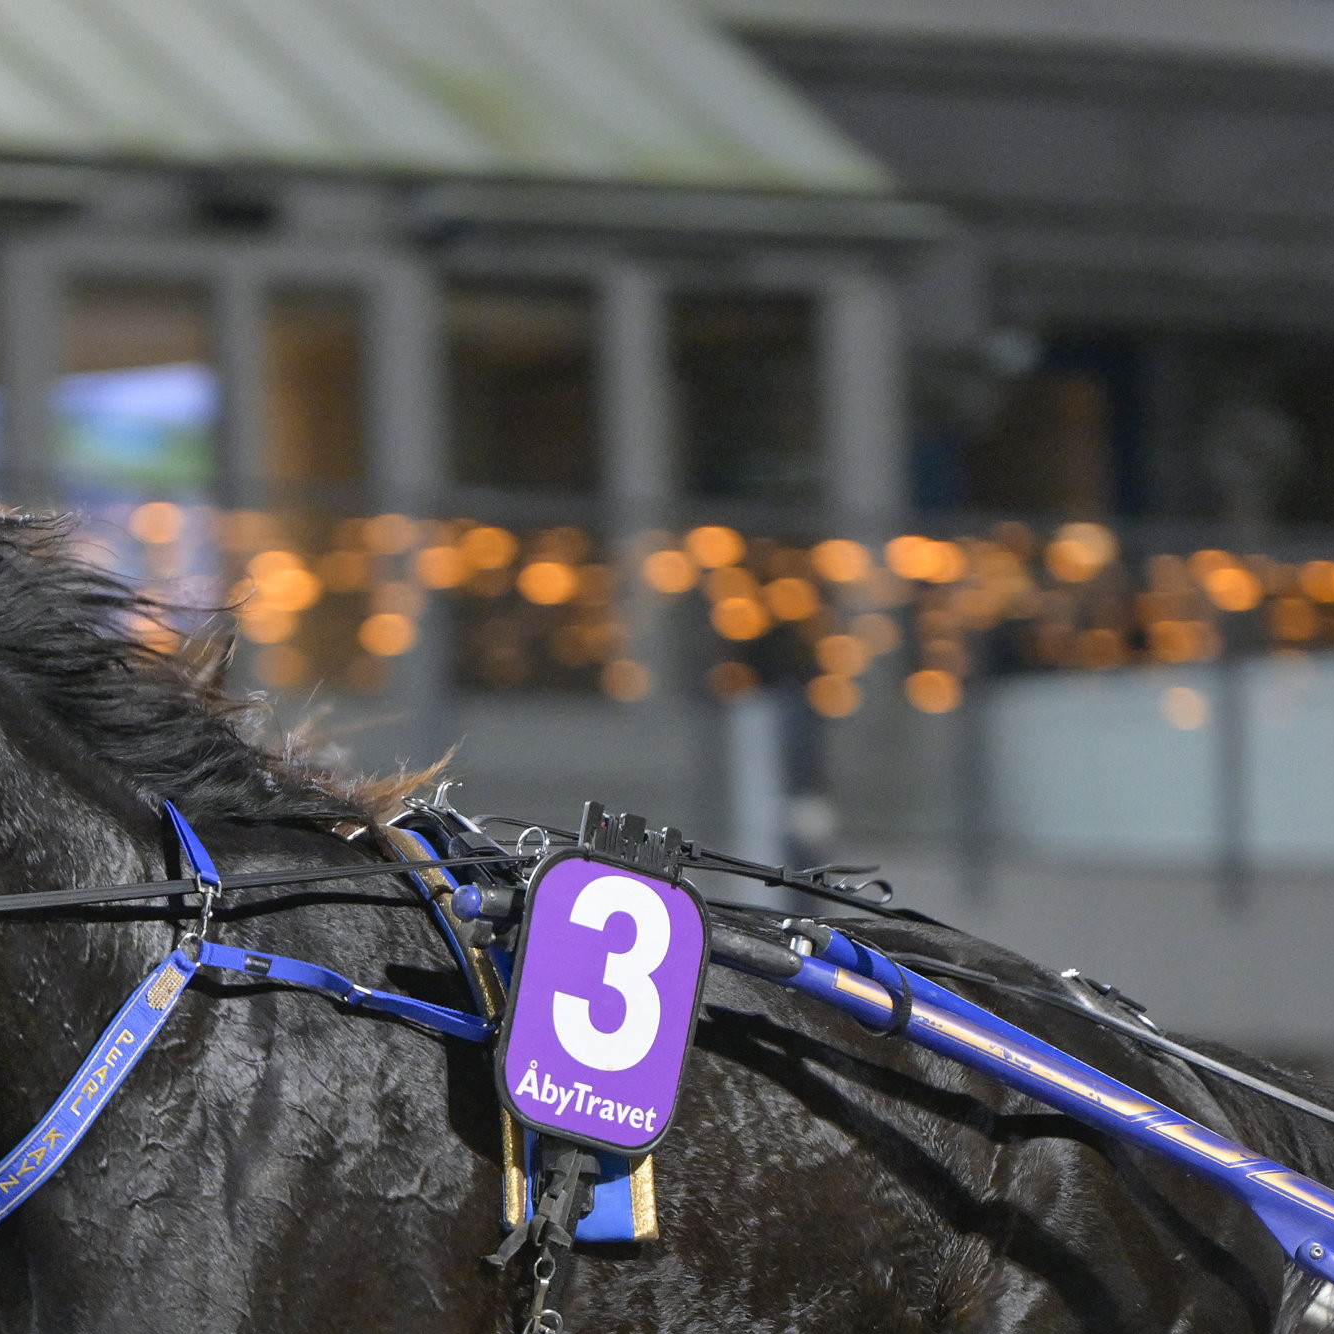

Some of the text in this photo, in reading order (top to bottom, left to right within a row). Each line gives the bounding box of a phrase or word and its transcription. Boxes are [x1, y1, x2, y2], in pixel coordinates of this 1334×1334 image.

[553, 875, 671, 1071] 3
[0, 1028, 135, 1194] PEARL KAYZ
[514, 1059, 657, 1132] ÅbyTravet
